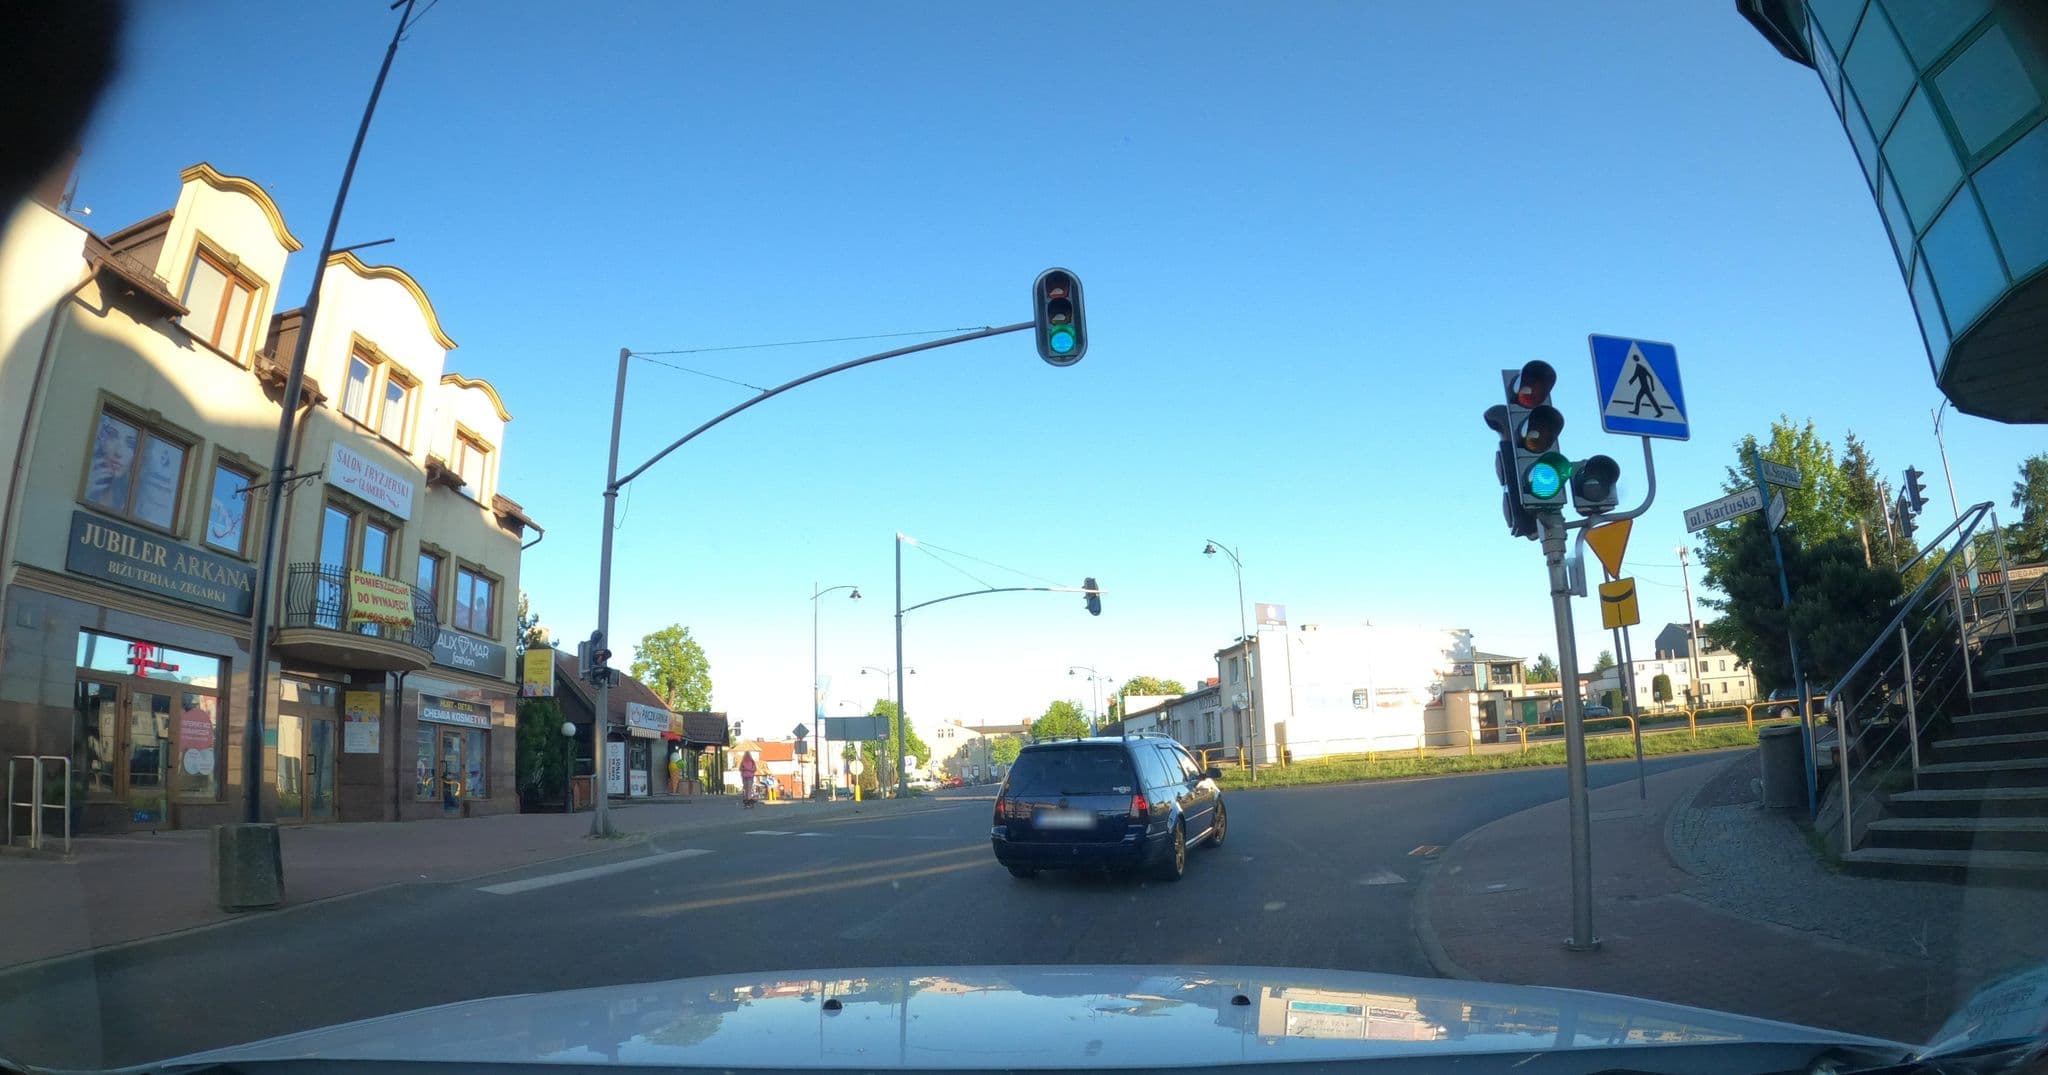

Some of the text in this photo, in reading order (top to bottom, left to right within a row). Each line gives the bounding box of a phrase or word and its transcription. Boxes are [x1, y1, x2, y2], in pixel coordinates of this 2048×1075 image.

[336, 449, 409, 497] SALON FRYZJERSKI
[81, 523, 250, 591] JUBILER ARKANA
[108, 560, 170, 588] BIŻUTERIA
[179, 581, 225, 602] ZEGARKI
[357, 591, 369, 604] DO
[452, 652, 475, 667] fashion
[469, 642, 489, 659] MAR
